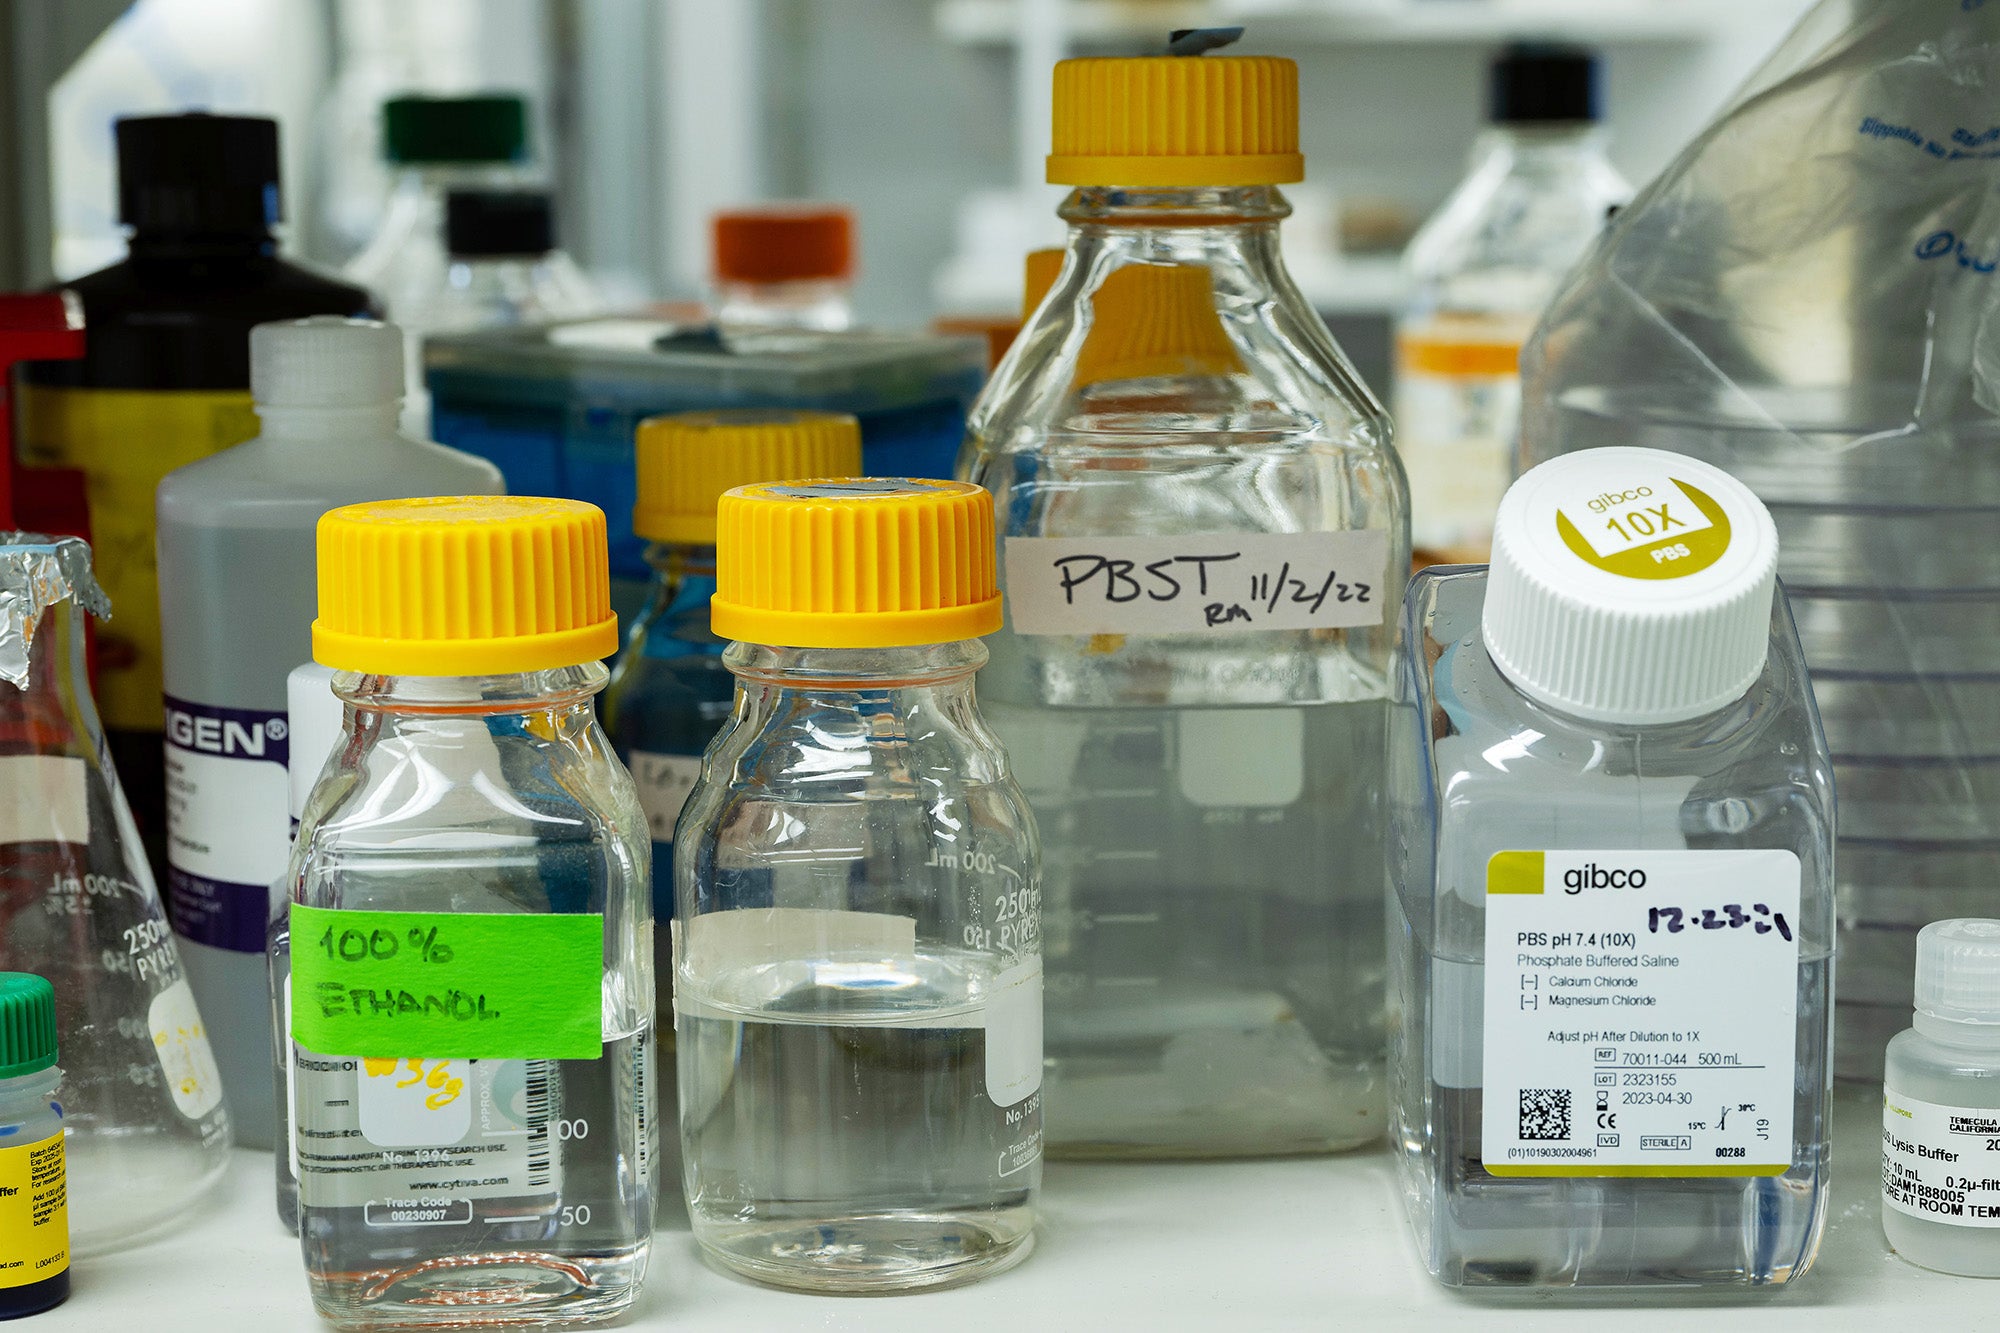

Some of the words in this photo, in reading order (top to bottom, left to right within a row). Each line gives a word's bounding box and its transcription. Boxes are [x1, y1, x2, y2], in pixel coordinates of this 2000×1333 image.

[1587, 486, 1653, 513] gibco
[1606, 503, 1687, 541] 10X
[1650, 543, 1691, 564] PBS
[1054, 552, 1241, 605] PBST
[1251, 562, 1371, 614] 11/2/22
[1563, 863, 1647, 895] gibco
[1517, 932, 1547, 946] PBS
[1552, 932, 1571, 949] pH
[1576, 932, 1596, 946] 7.4
[1600, 932, 1636, 949] (10X)
[1517, 953, 1582, 969] Phosphate
[1586, 954, 1638, 967] Buffered
[1641, 954, 1679, 967] Saline
[1549, 975, 1591, 987] Calcium
[1593, 975, 1638, 987] Chloride
[316, 981, 500, 1021] ETHANOL
[1549, 995, 1609, 1008] Magnesium
[1612, 995, 1656, 1006] Chloride
[1548, 1030, 1580, 1044] Adjust
[1583, 1031, 1599, 1042] pH
[1601, 1031, 1626, 1042] After
[1630, 1031, 1669, 1042] Dilution
[1672, 1031, 1683, 1042] to
[1686, 1031, 1700, 1042] 1X
[1622, 1053, 1687, 1065] 70011-044
[1698, 1053, 1722, 1065] 500
[1723, 1054, 1742, 1065] mL
[1622, 1074, 1677, 1086] 2323155
[1622, 1091, 1693, 1105] 2023-04-30
[1949, 1116, 1998, 1126] TEMECULA
[1756, 1119, 1769, 1141] J19
[1600, 1136, 1617, 1144] IVD
[1642, 1139, 1677, 1147] STERILE
[1680, 1139, 1688, 1147] A
[30, 1149, 47, 1158] Batch
[1507, 1148, 1597, 1159] (01)10190302004961
[1715, 1147, 1746, 1157] 00288
[1892, 1134, 1915, 1155] Lysis
[1918, 1144, 1960, 1163] Buffer
[31, 1158, 43, 1166] Exp
[414, 1149, 450, 1162] 1396
[32, 1165, 47, 1174] Store
[1893, 1162, 1903, 1176] 10
[1905, 1169, 1922, 1183] mL
[32, 1181, 42, 1189] For
[409, 1176, 510, 1190] www.cytiva.com
[32, 1193, 45, 1202] Add
[384, 1197, 418, 1208] Trace
[421, 1196, 453, 1207] Code
[1902, 1192, 1916, 1206] AT
[1918, 1198, 1964, 1217] ROOM
[391, 1209, 447, 1221] 00230907
[560, 1204, 591, 1227] 50
